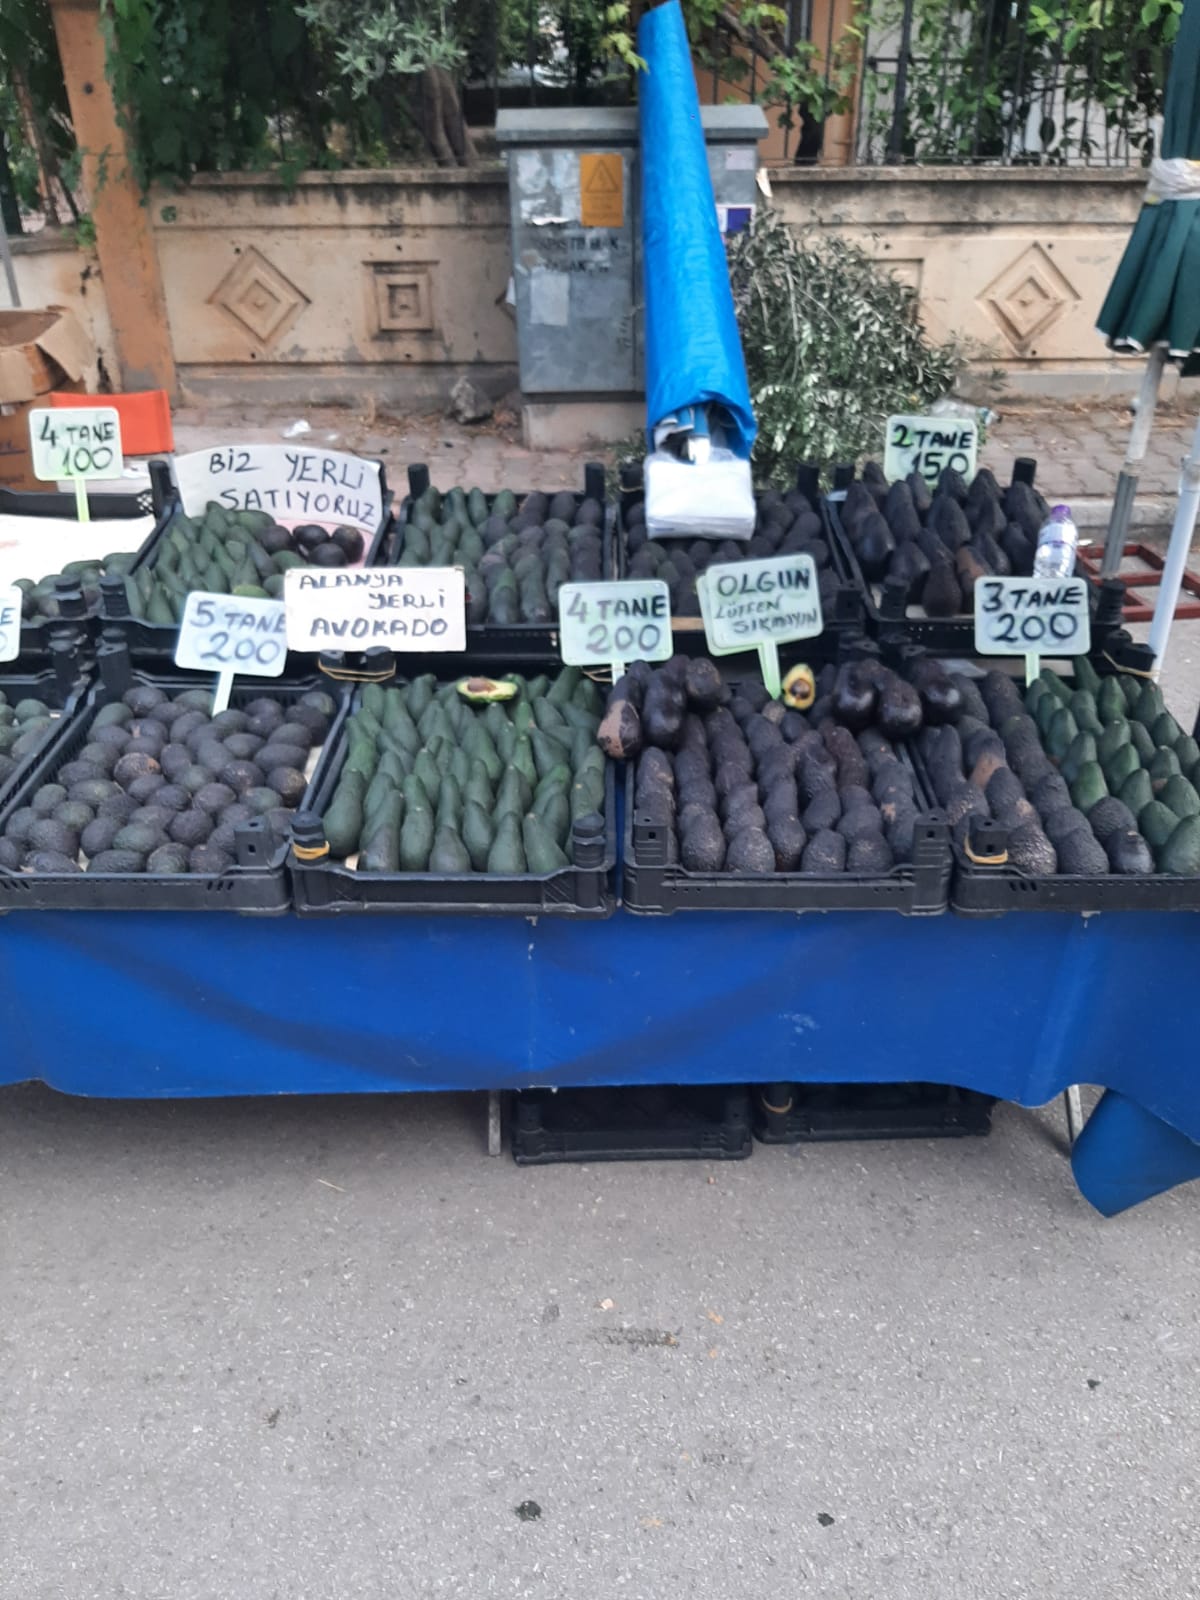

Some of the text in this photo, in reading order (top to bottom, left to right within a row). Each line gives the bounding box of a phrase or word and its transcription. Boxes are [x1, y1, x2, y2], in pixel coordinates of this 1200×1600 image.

[39, 415, 115, 448] 4 TANE
[891, 424, 974, 449] 2 TANE
[62, 447, 114, 476] 100
[911, 452, 969, 480] 150
[220, 488, 375, 527] SATIYORUZ
[299, 574, 404, 589] ALANYA
[566, 592, 667, 624] 4 TANE
[982, 582, 1083, 612] 3 TANE
[189, 601, 286, 633] 5 TANE
[310, 617, 449, 638] AVOKADO
[993, 612, 1078, 642] 200
[200, 632, 281, 665] 200
[586, 624, 661, 655] 200
